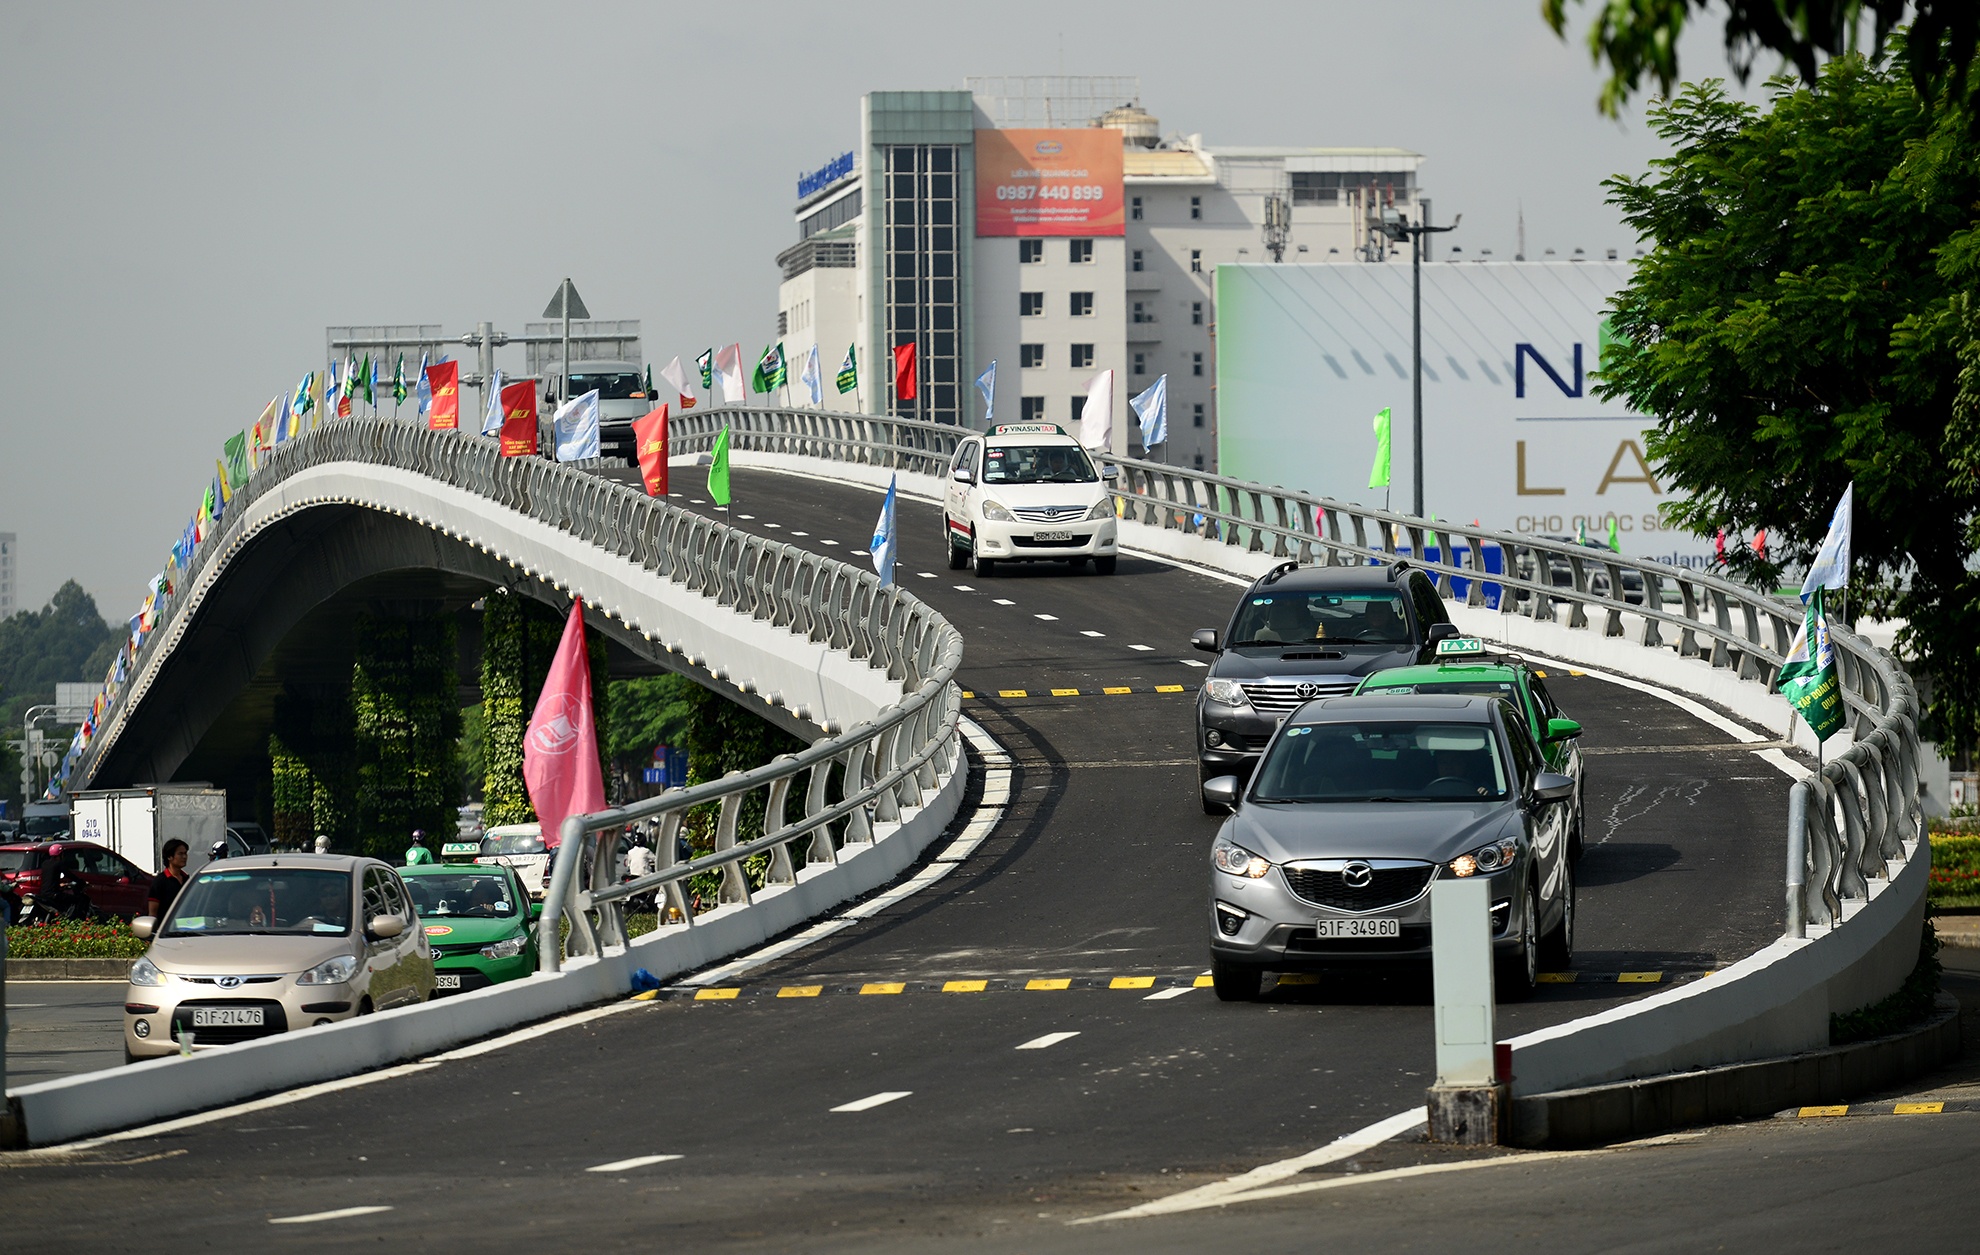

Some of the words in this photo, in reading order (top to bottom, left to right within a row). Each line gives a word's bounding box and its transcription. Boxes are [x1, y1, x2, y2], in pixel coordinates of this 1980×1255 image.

[997, 185, 1037, 200] 0987
[1038, 185, 1070, 200] 440
[1072, 185, 1103, 200] 899
[1516, 515, 1563, 533] CHO
[1319, 920, 1397, 936] 51F-349.60
[195, 1010, 261, 1024] 51F-214.76
